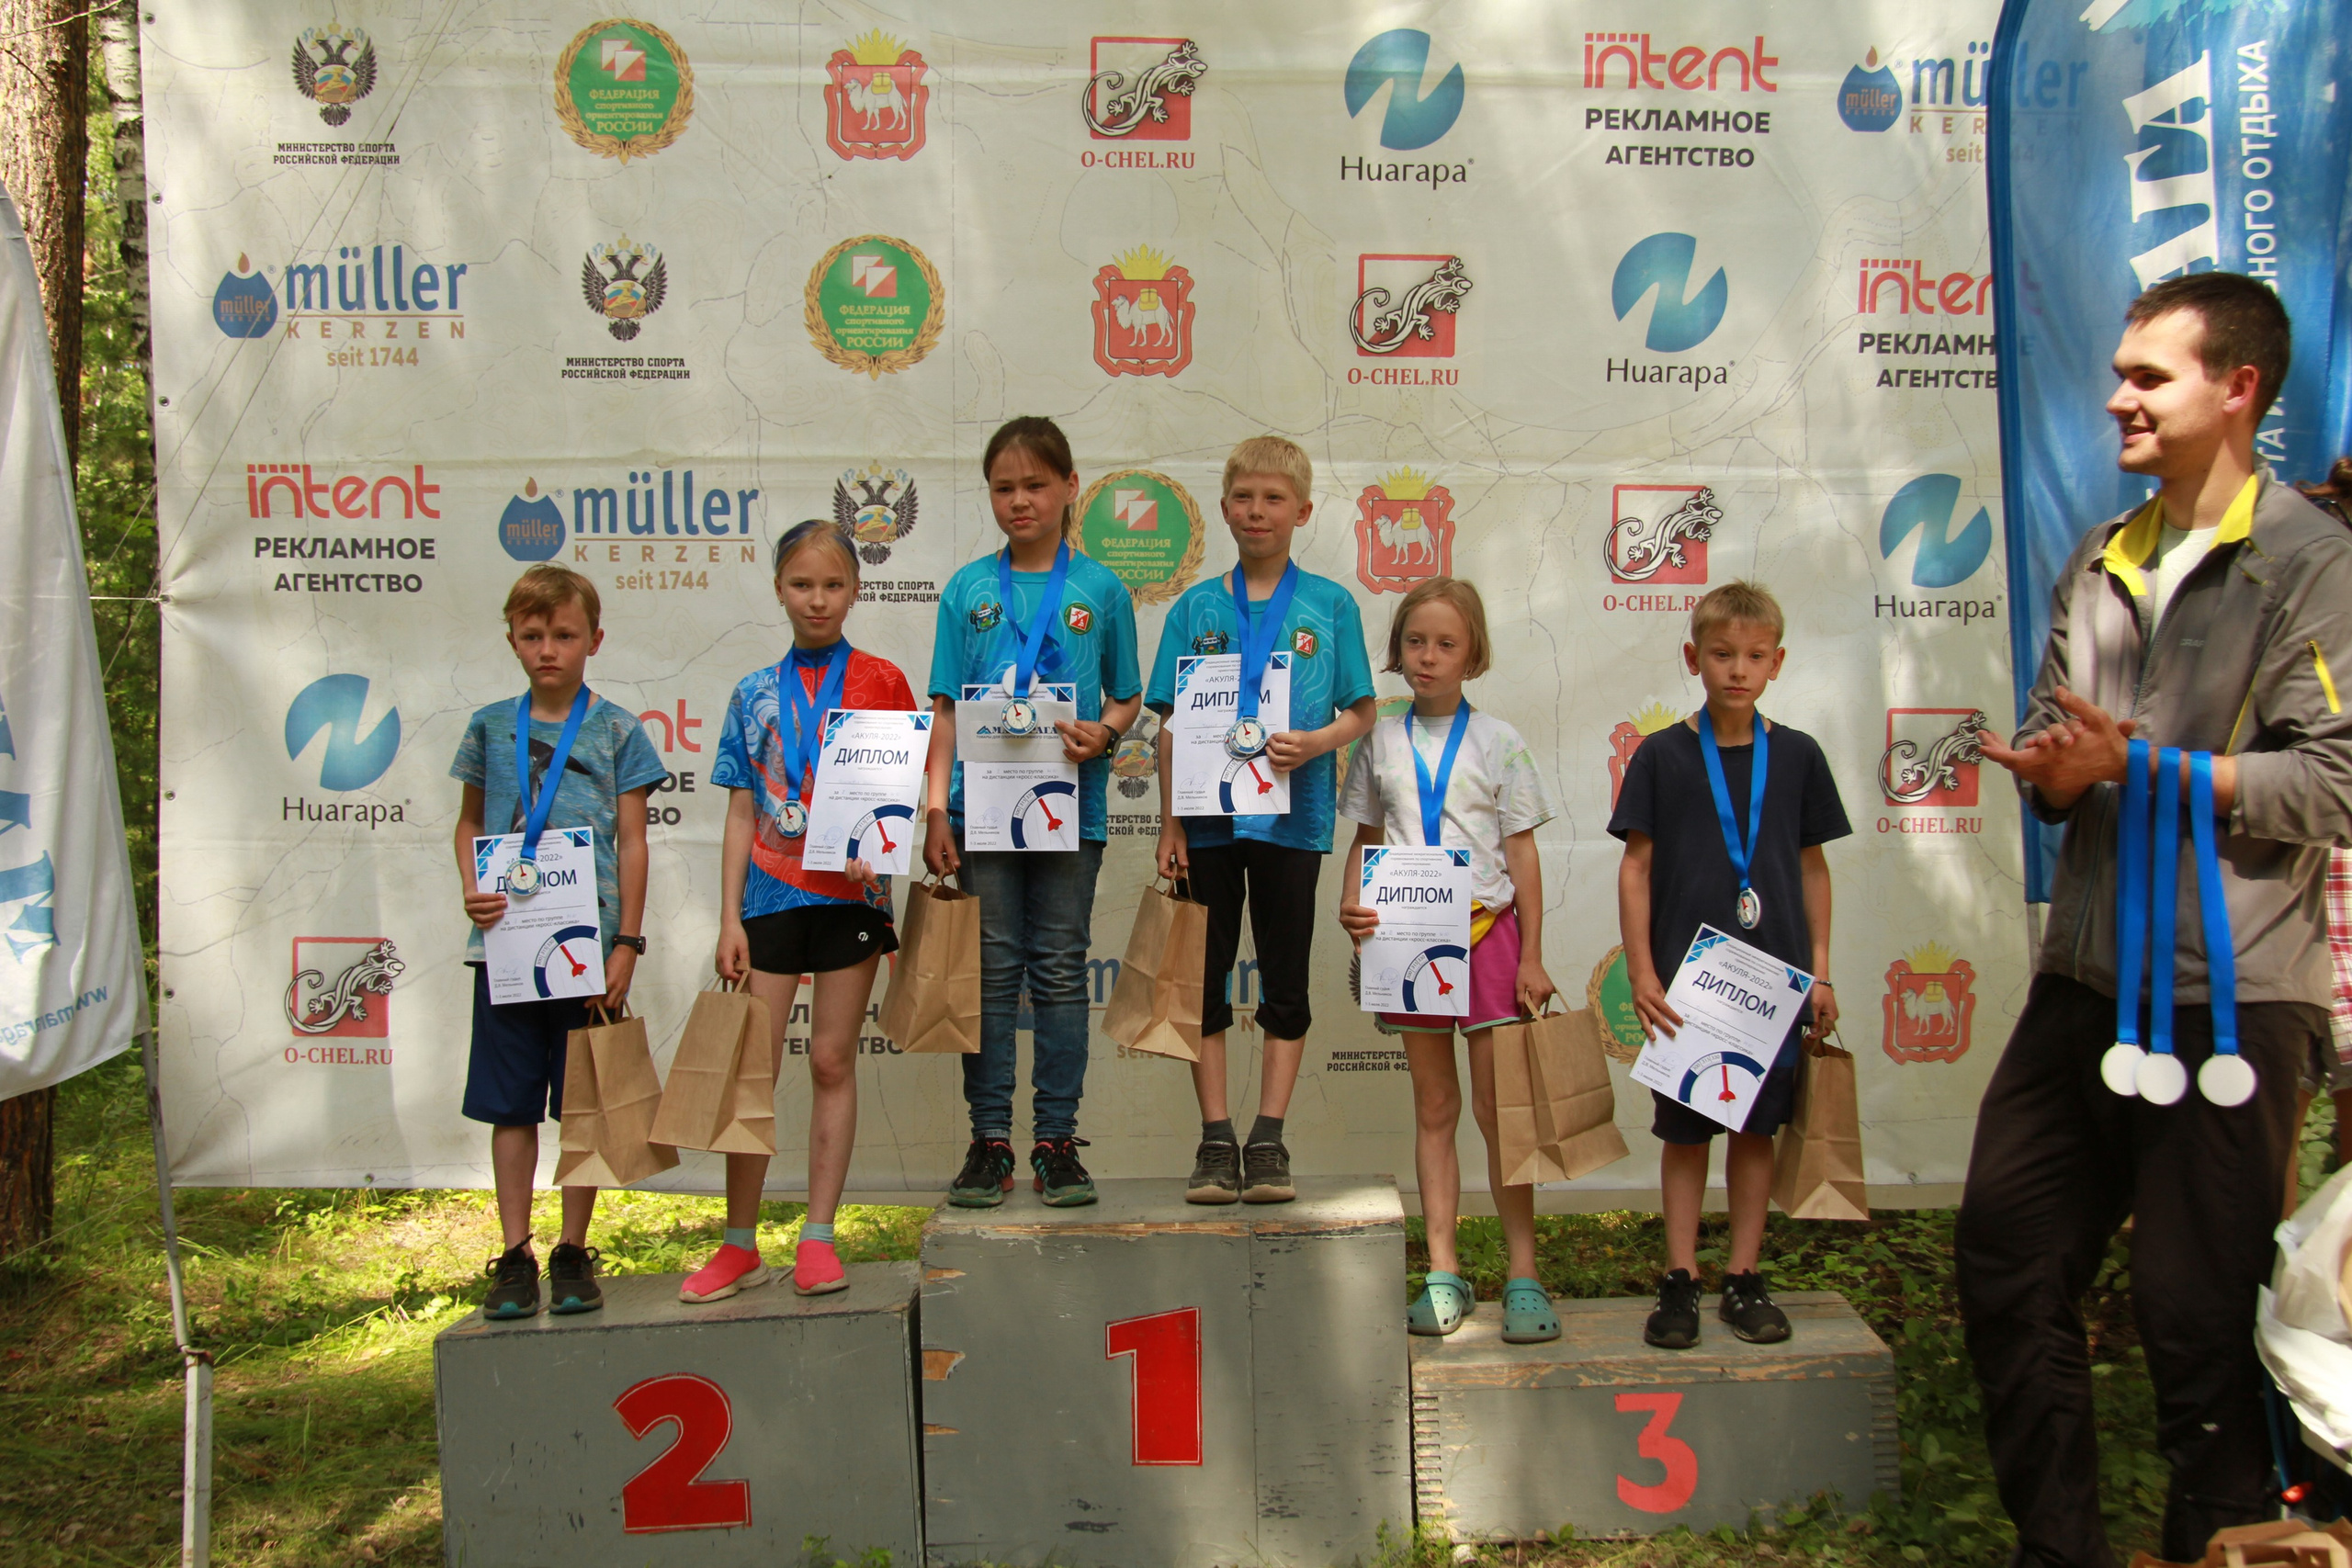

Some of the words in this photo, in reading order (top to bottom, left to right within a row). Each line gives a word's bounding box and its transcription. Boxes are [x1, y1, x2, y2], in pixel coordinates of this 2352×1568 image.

[1584, 32, 1779, 92] intent
[589, 89, 660, 101] ФЕДЕРАЦИЯ
[2237, 40, 2278, 180] ОТДЫХА
[596, 121, 653, 132] РОССИИ
[1585, 108, 1770, 134] РЕКЛАМНОЕ
[277, 143, 355, 153] МИНИСТЕРСТВО
[358, 143, 396, 154] СПОРТА
[1605, 145, 1755, 168] АГЕНТСТВО
[274, 153, 336, 165] РОССИЙСКОЙ
[340, 154, 401, 165] ФЕДЕРАЦИИ
[1080, 151, 1195, 170] O-CHEL.RU
[286, 245, 468, 311] müller
[839, 305, 910, 317] ФЕДЕРАЦИЯ
[288, 321, 465, 340] KERZEN
[846, 336, 903, 347] РОССИИ
[327, 347, 364, 367] seit
[369, 347, 419, 367] 1744
[566, 357, 643, 367] МИНИСТЕРСТВО
[648, 357, 685, 368] СПОРТА
[561, 367, 626, 379] РОССИЙСКОЙ
[629, 368, 690, 380] ФЕДЕРАЦИИ
[1347, 367, 1459, 386] O-CHEL.RU
[1876, 369, 1998, 389] АГЕНТСТВ
[247, 464, 441, 520] intent
[574, 470, 760, 536] müller
[254, 536, 435, 560] РЕКЛАМНОЕ
[1102, 537, 1171, 549] ФЕДЕРАЦИЯ
[575, 546, 756, 563] KERZEN
[275, 573, 424, 593] АГЕНТСТВО
[616, 570, 653, 591] seit
[659, 570, 709, 591] 1744
[898, 581, 935, 591] СПОРТА
[879, 592, 941, 603] ФЕДЕРАЦИИ
[1192, 690, 1271, 710] ДИПЛМ
[834, 748, 909, 766] ДИПЛОМ
[1876, 816, 1983, 835] O-CHEL.RU
[1389, 869, 1442, 877] «АКУЛЯ-2022»
[1376, 886, 1453, 905] ДИПЛОМ
[1718, 961, 1773, 990] «АКУЛЯ-2022»
[1692, 970, 1777, 1020] ДИПЛОМ
[284, 1047, 393, 1066] O-CHEL.RU
[1327, 1061, 1390, 1071] РОССИЙСКОЙ
[1104, 1306, 1202, 1468] 1
[612, 1372, 752, 1537] 2
[1614, 1391, 1699, 1515] 3
